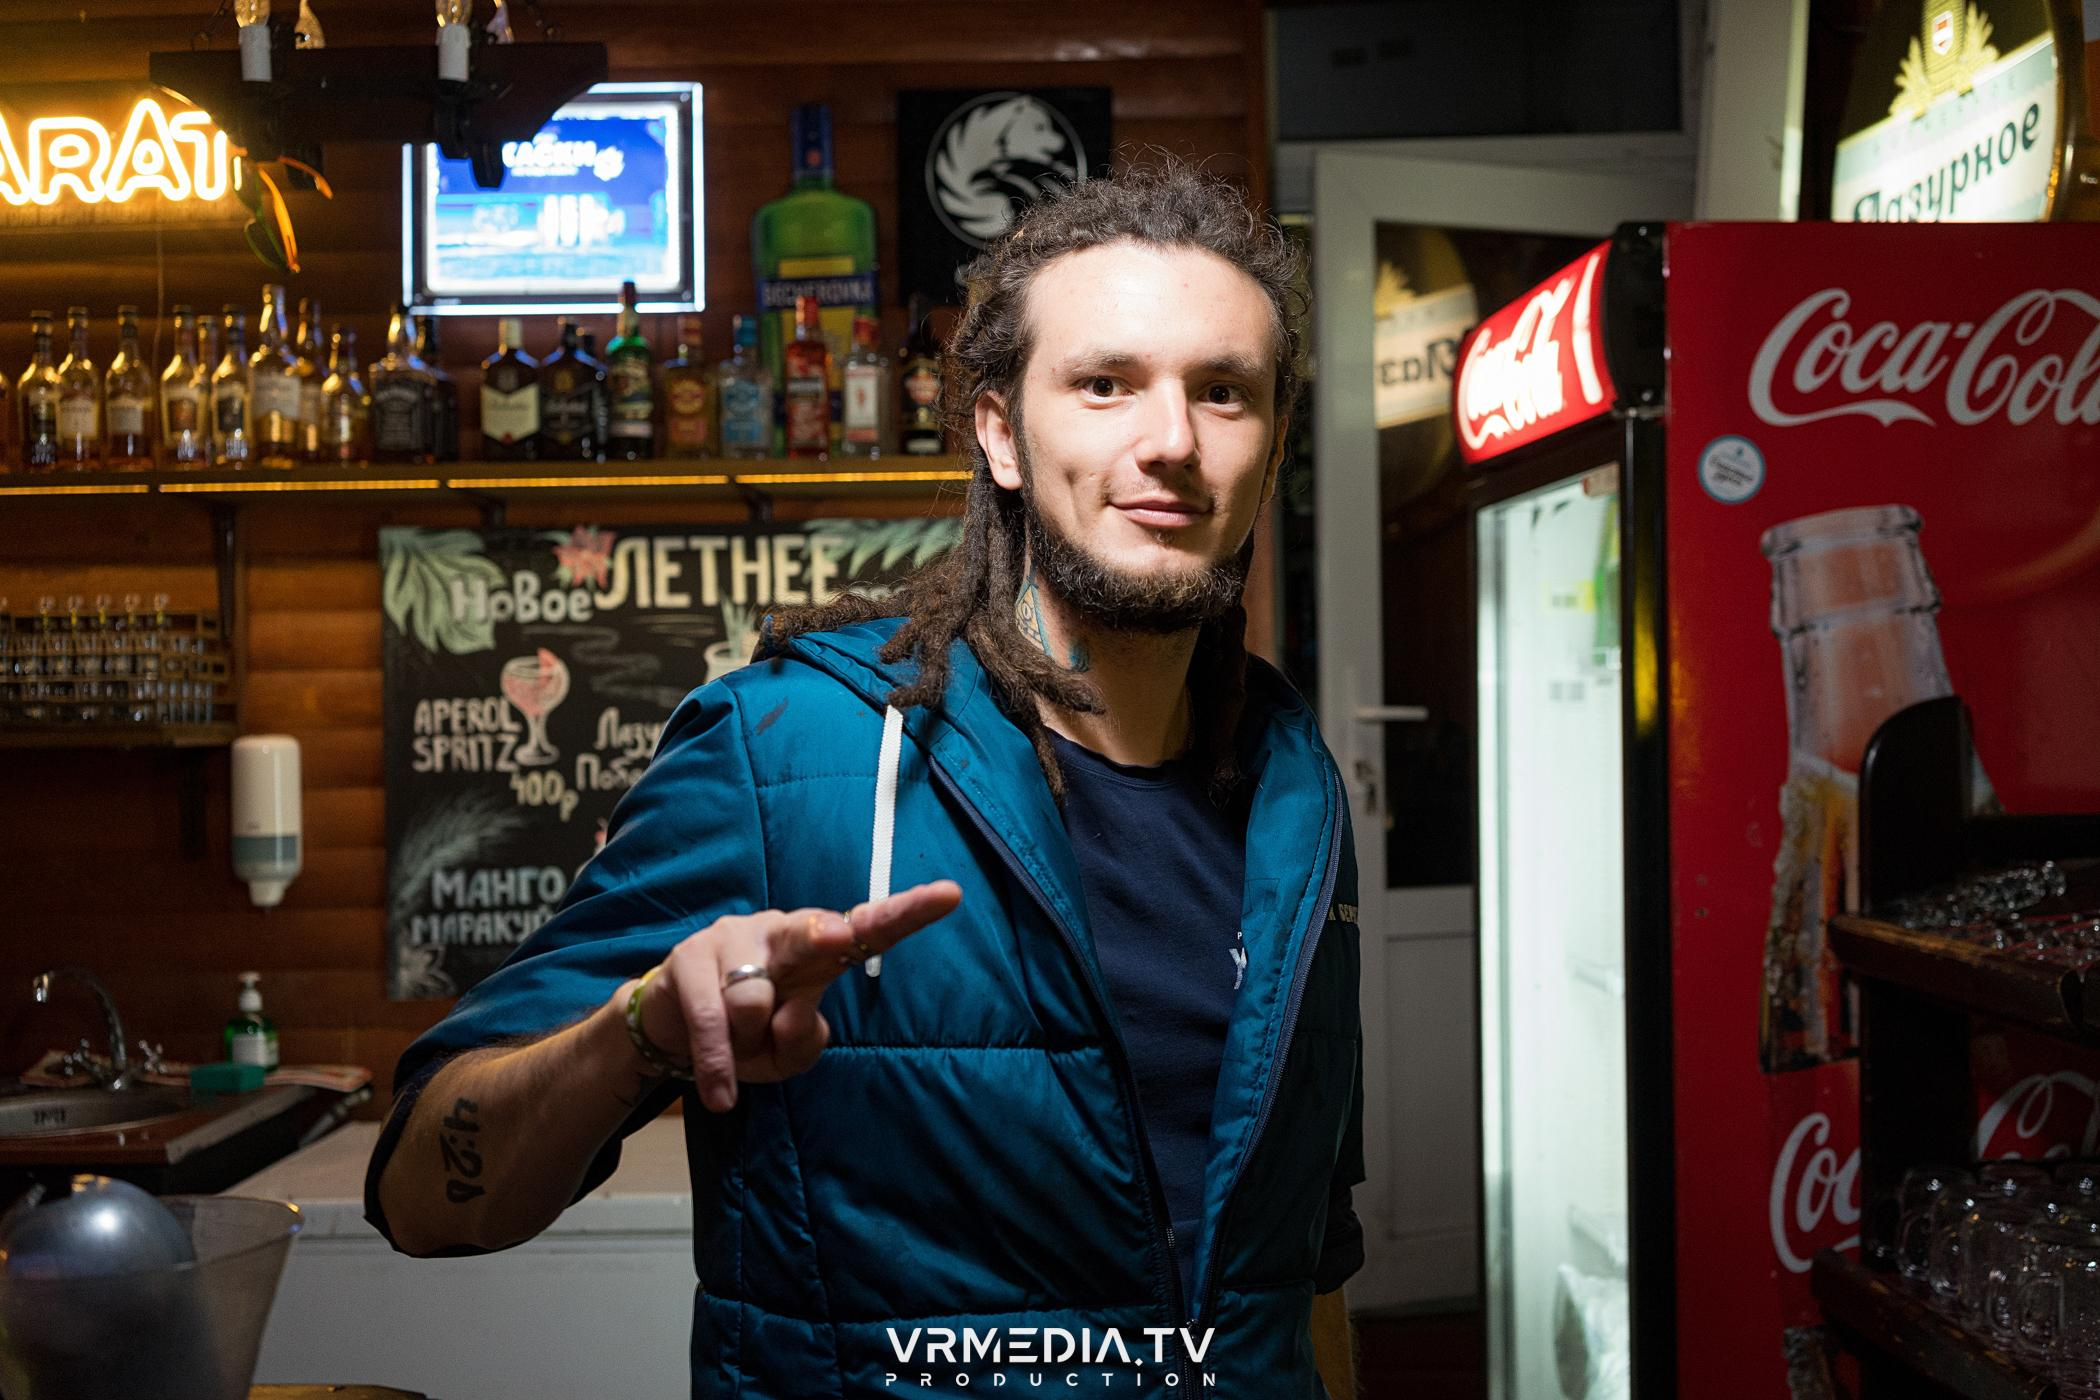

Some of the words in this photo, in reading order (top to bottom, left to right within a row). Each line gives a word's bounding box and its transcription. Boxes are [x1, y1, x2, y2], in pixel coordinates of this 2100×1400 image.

[413, 697, 523, 735] APEROL
[411, 733, 520, 773] SPRITZ
[431, 865, 567, 910] МАНГО
